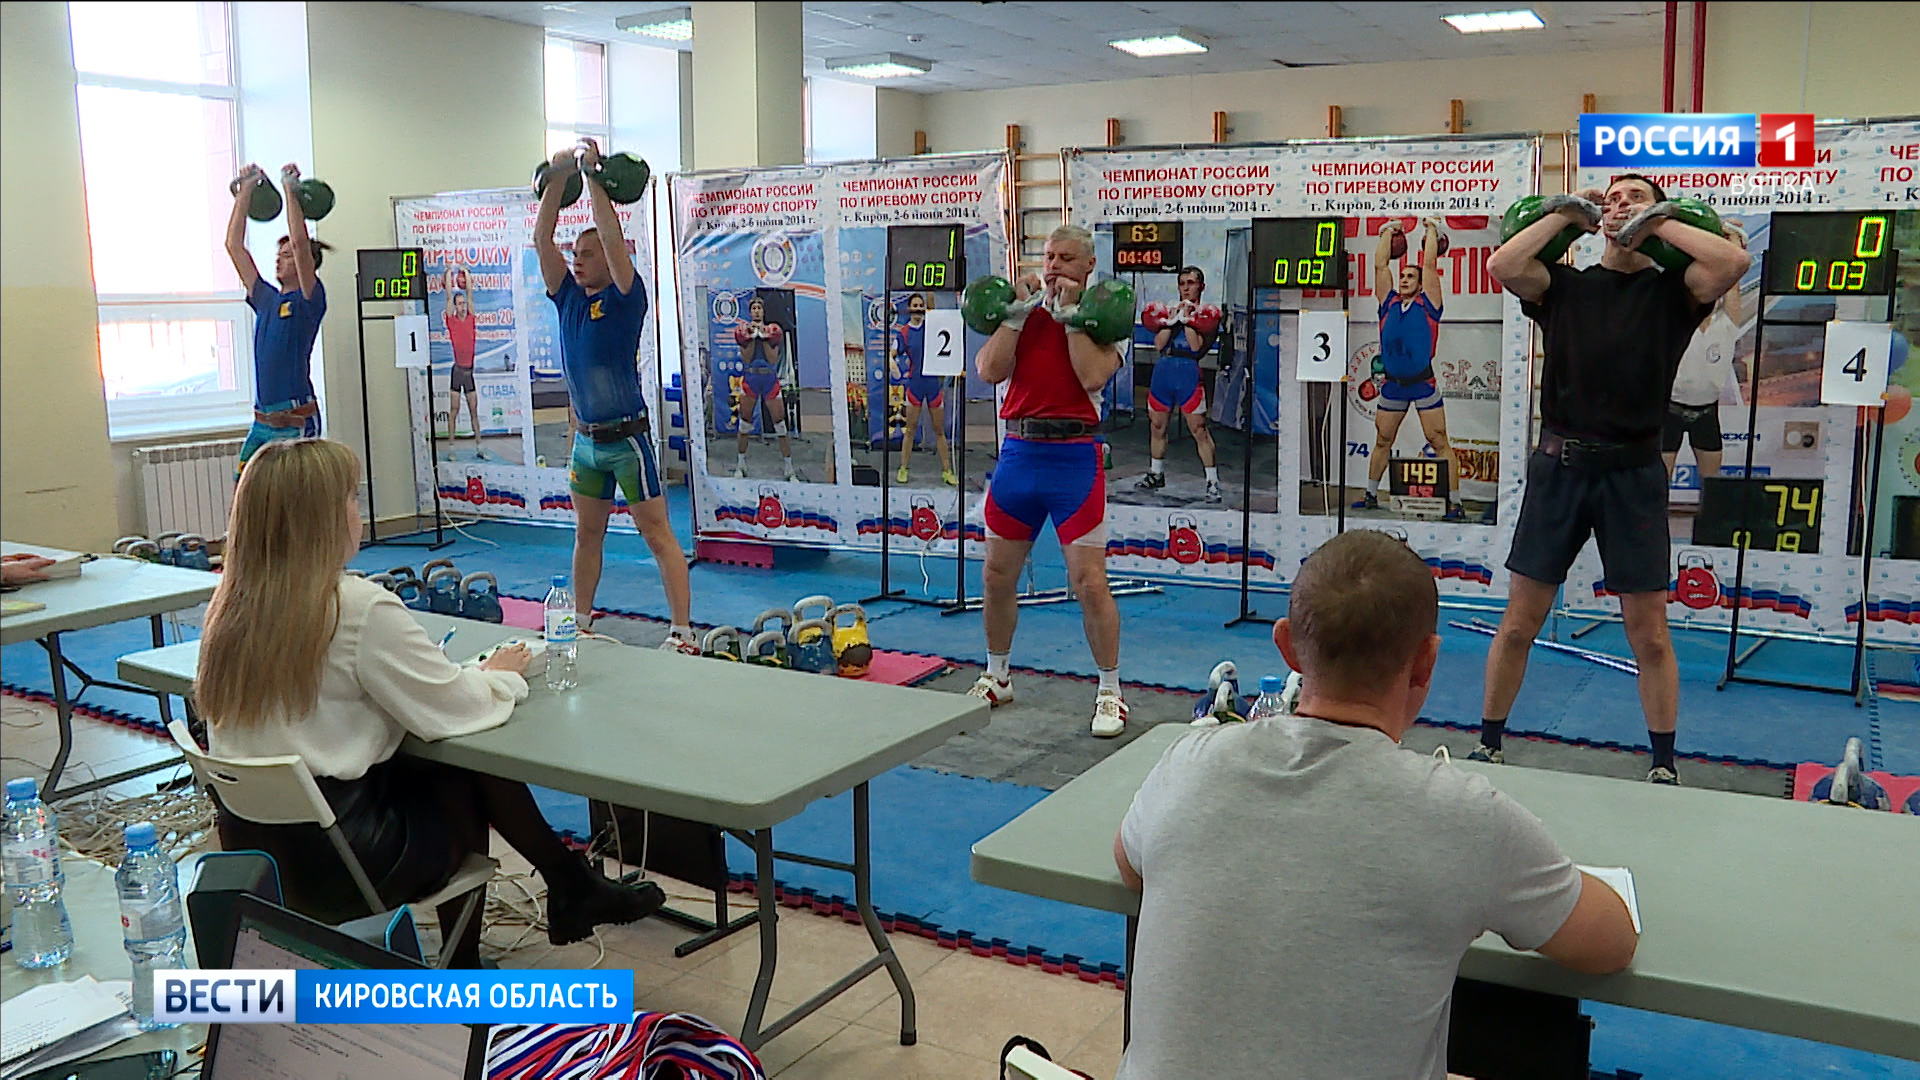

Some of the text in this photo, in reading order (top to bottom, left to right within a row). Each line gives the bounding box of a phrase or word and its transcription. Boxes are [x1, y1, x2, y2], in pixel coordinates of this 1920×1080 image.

[1103, 165, 1269, 183] ЧЕМПИОНАТ РОССИИ
[1311, 159, 1495, 177] ЧЕМПИОНАТ РОССИИ
[1880, 167, 1913, 183] ПО
[843, 173, 977, 192] ЧЕМПИОНАТ РОССИИ
[1306, 178, 1501, 195] ПО ГИРЕВОМУ СПОРТУ
[1753, 169, 1839, 188] СПОРТУ
[692, 183, 814, 205] ЧЕМПИОНАТ РОССИИ
[840, 190, 982, 208] ПО ГИРЕВОМУ СПОРТУ
[1098, 183, 1276, 201] ПО ГИРЕВОМУ СПОРТУ
[1722, 194, 1770, 206] июня
[1775, 190, 1813, 204] 2014
[413, 205, 505, 221] ЧЕМПИОНАТ РОССИИ
[691, 199, 817, 219] ПО ГИРЕВОМУ СПОРТУ
[854, 211, 892, 224] Киров,
[894, 209, 909, 220] 2-6
[912, 210, 943, 220] июня
[945, 207, 969, 218] 2014
[1116, 205, 1161, 218] Киров,
[1165, 203, 1184, 214] 2-6
[1187, 204, 1225, 214] июня
[1229, 201, 1257, 212] 2014
[1325, 199, 1375, 214] Киров,
[1379, 198, 1400, 210] 2-6
[1403, 200, 1445, 210] июня
[1449, 197, 1480, 209] 2014
[412, 219, 508, 234] ПО ГИРЕВОМУ СПОРТУ
[1131, 223, 1159, 243] 63
[948, 229, 955, 260] 1
[1316, 222, 1337, 257] 0
[1855, 216, 1887, 258] 0
[402, 250, 417, 277] 0
[422, 246, 510, 266] ИРЕВОМУ
[1117, 250, 1162, 265] 04:49
[904, 262, 946, 286] 0 03
[1274, 259, 1290, 285] 0
[1297, 259, 1325, 285] 03
[1796, 260, 1868, 291] 0 03
[374, 278, 386, 298] 0
[390, 278, 410, 298] 03
[408, 331, 417, 352] 1
[937, 329, 952, 357] 2
[1313, 331, 1331, 363] 3
[1841, 347, 1868, 382] 4
[1347, 441, 1370, 458] 74
[1402, 462, 1438, 484] 149
[1764, 485, 1820, 528] 74
